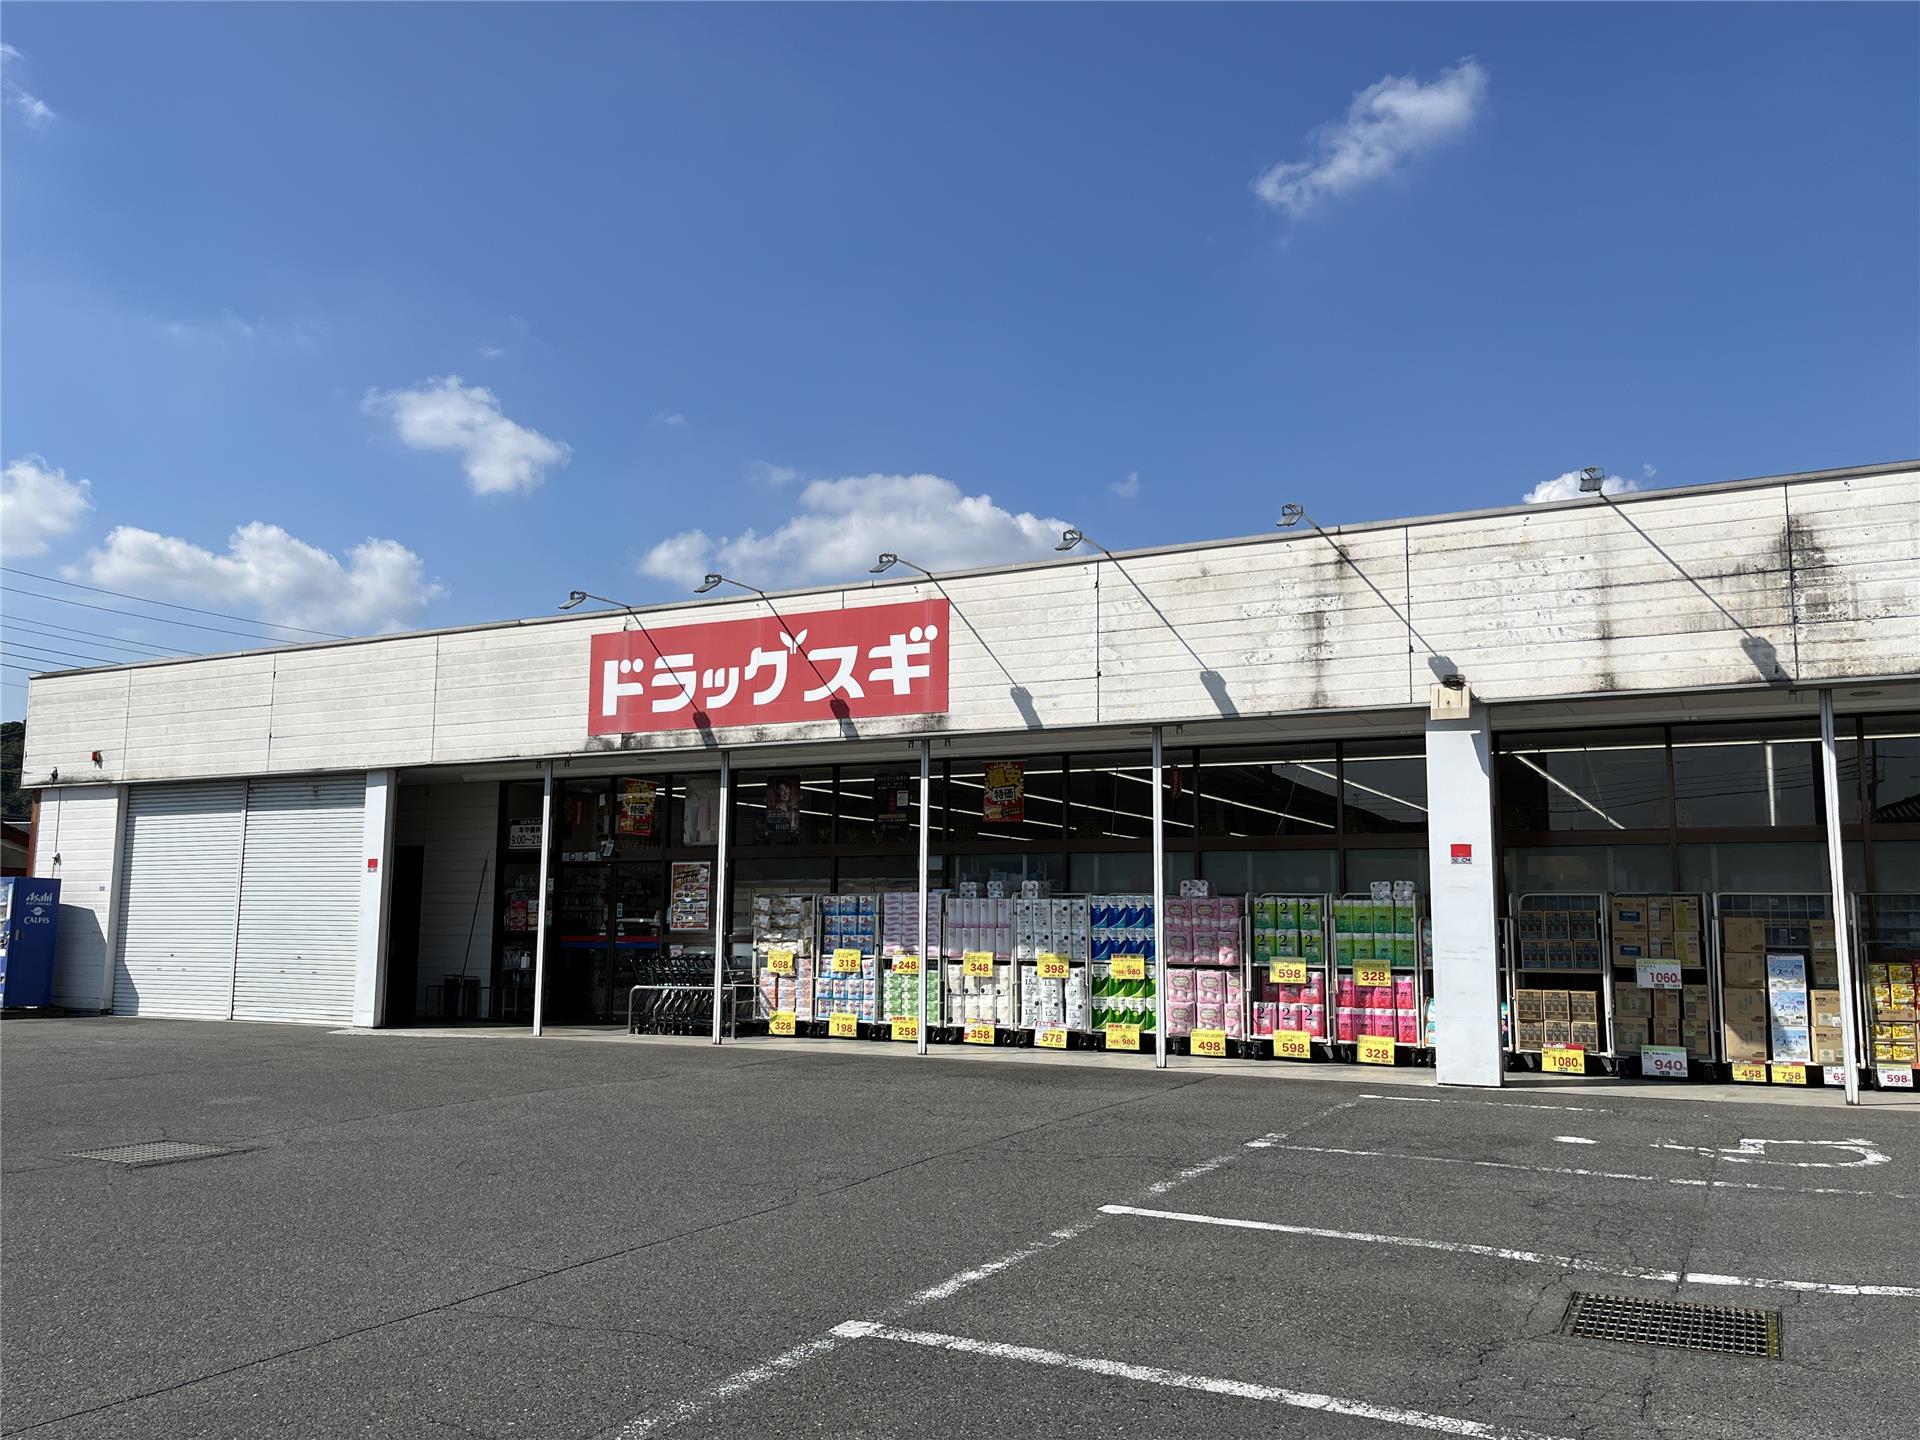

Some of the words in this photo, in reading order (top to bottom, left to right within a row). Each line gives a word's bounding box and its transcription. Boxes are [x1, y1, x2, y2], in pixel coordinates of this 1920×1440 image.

[602, 624, 939, 716] ドラッグスギ
[26, 891, 53, 902] Asahi
[1257, 902, 1264, 914] 2
[1280, 902, 1288, 914] 2
[1302, 903, 1310, 915] 2
[24, 916, 50, 925] CALPIS
[1257, 934, 1265, 946] 2
[1279, 934, 1287, 946] 2
[1305, 935, 1313, 947] 2
[772, 960, 788, 969] 698
[838, 960, 856, 968] 318
[898, 961, 916, 970] 248
[970, 963, 988, 972] 348
[1044, 964, 1064, 974] 398
[1278, 969, 1301, 978] 598
[1362, 972, 1386, 981] 328
[1649, 972, 1678, 983] 1060
[1258, 1006, 1264, 1018] 2
[1282, 1008, 1290, 1020] 2
[1305, 1008, 1313, 1020] 2
[775, 1022, 792, 1030] 328
[836, 1024, 852, 1032] 198
[898, 1028, 916, 1036] 258
[970, 1030, 990, 1038] 358
[1042, 1034, 1062, 1043] 578
[1198, 1042, 1221, 1051] 498
[1282, 1044, 1304, 1053] 598
[1366, 1048, 1389, 1059] 328
[1552, 1056, 1578, 1068] 1080
[1654, 1060, 1683, 1070] 940
[1742, 1070, 1762, 1078] 458
[1781, 1072, 1801, 1080] 758
[1834, 1073, 1846, 1081] 62
[1887, 1074, 1908, 1083] 598
